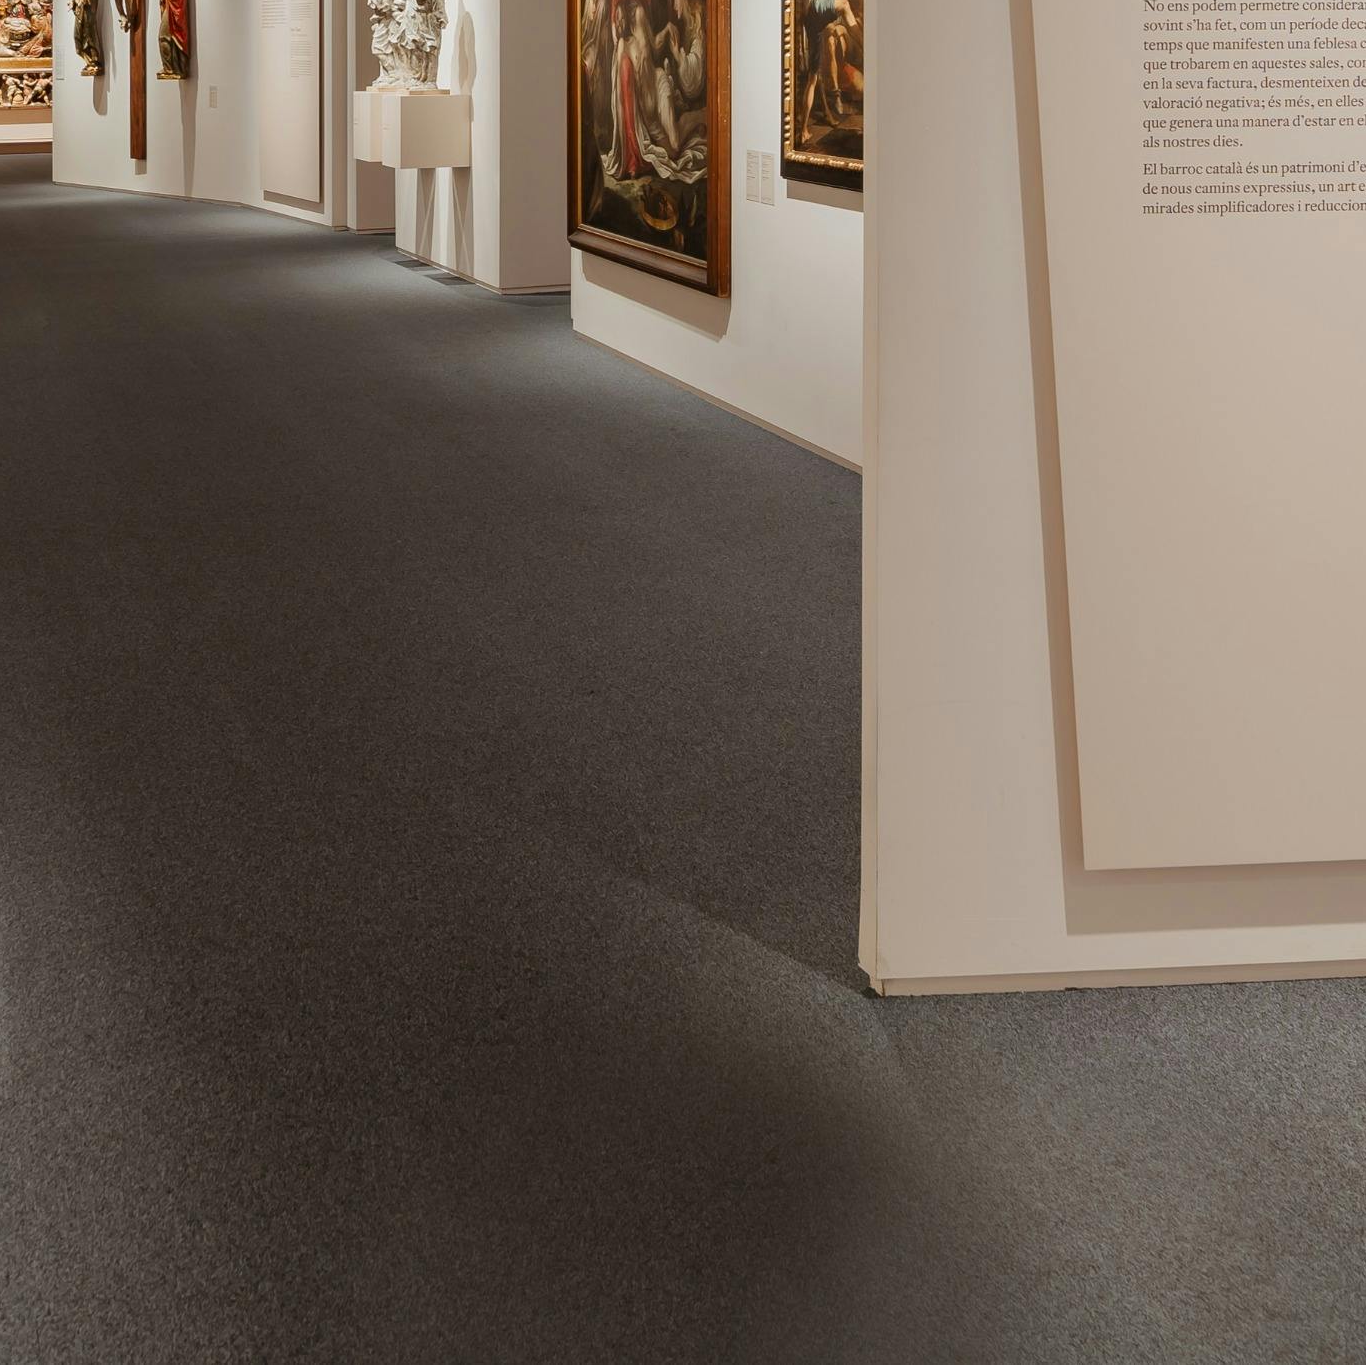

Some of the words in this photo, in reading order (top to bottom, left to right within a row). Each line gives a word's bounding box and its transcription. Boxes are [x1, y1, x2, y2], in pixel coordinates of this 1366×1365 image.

[1143, 162, 1157, 175] El
[1160, 161, 1203, 175] barroc
[1205, 161, 1242, 174] català
[1245, 161, 1260, 174] és
[1262, 164, 1278, 174] un
[1281, 161, 1345, 177] patrimoni
[1142, 181, 1160, 194] de
[1162, 184, 1193, 194] nous
[1195, 181, 1240, 193] camins
[1242, 180, 1316, 197] expressius,
[1318, 182, 1335, 192] un
[1337, 180, 1357, 192] art
[1142, 200, 1195, 214] mirades
[1197, 199, 1295, 217] simplificadores
